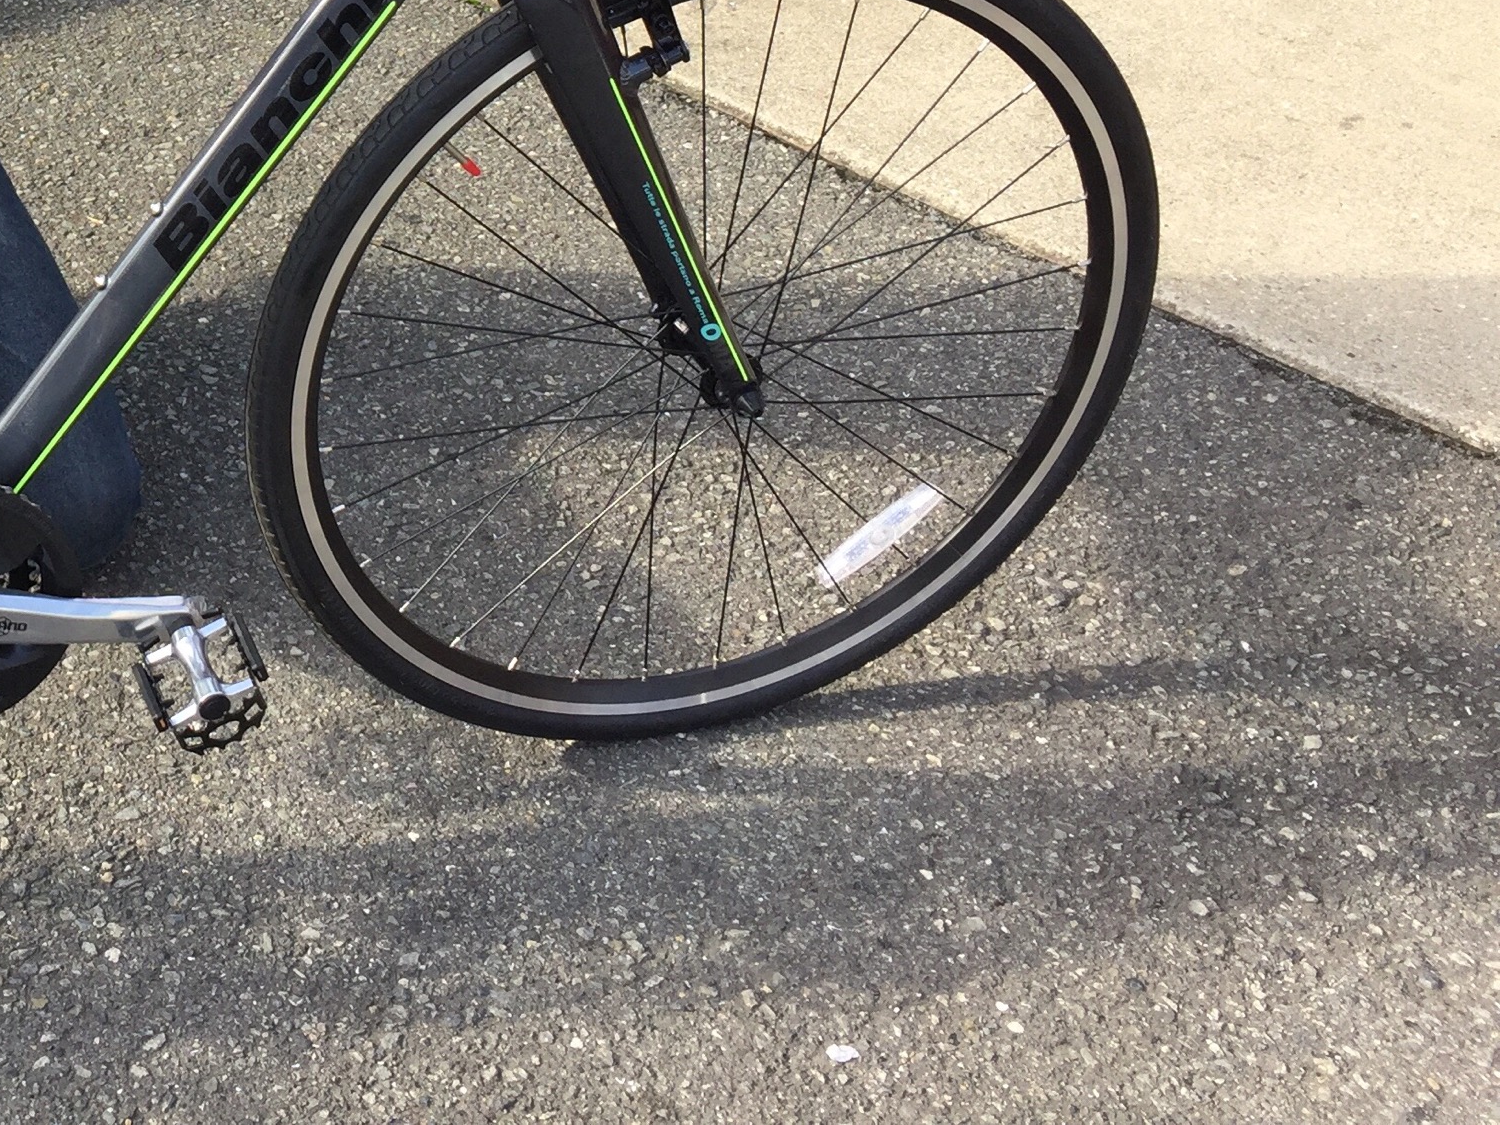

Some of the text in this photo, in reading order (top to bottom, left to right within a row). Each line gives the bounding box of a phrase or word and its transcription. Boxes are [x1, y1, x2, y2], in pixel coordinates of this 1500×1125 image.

[658, 219, 675, 249] strada
[670, 250, 692, 287] portano
[692, 296, 709, 324] Roma
